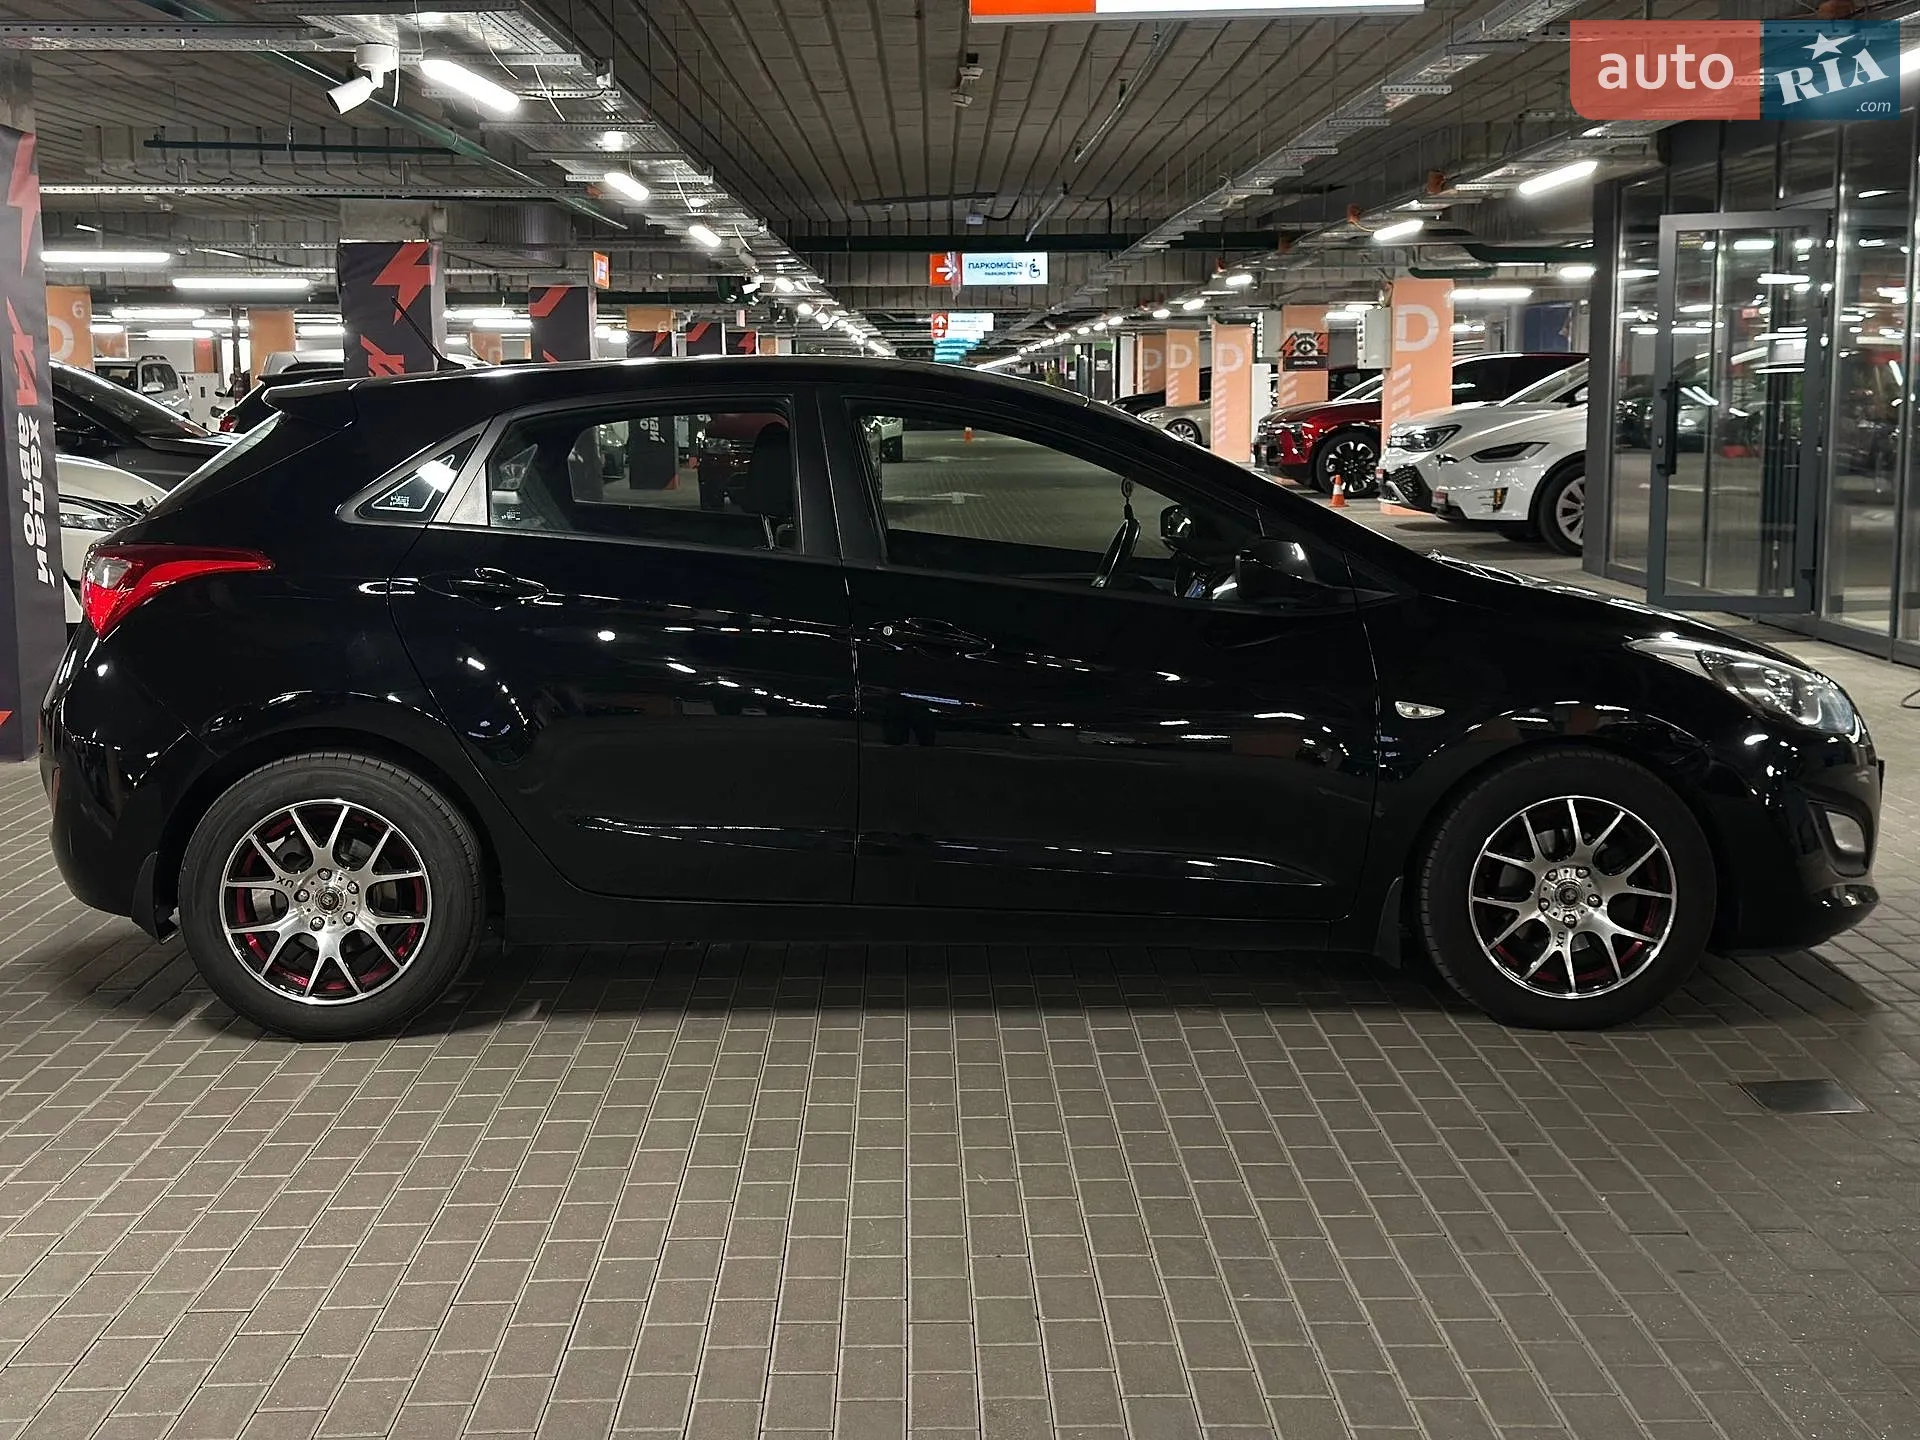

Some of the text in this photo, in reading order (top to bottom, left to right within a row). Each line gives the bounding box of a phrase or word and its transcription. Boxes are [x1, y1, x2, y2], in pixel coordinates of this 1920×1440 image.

[71, 300, 84, 319] 6
[1395, 304, 1439, 352] D
[1142, 348, 1163, 371] D
[1169, 343, 1192, 369] D
[1215, 343, 1244, 373] D
[17, 412, 36, 547] авто
